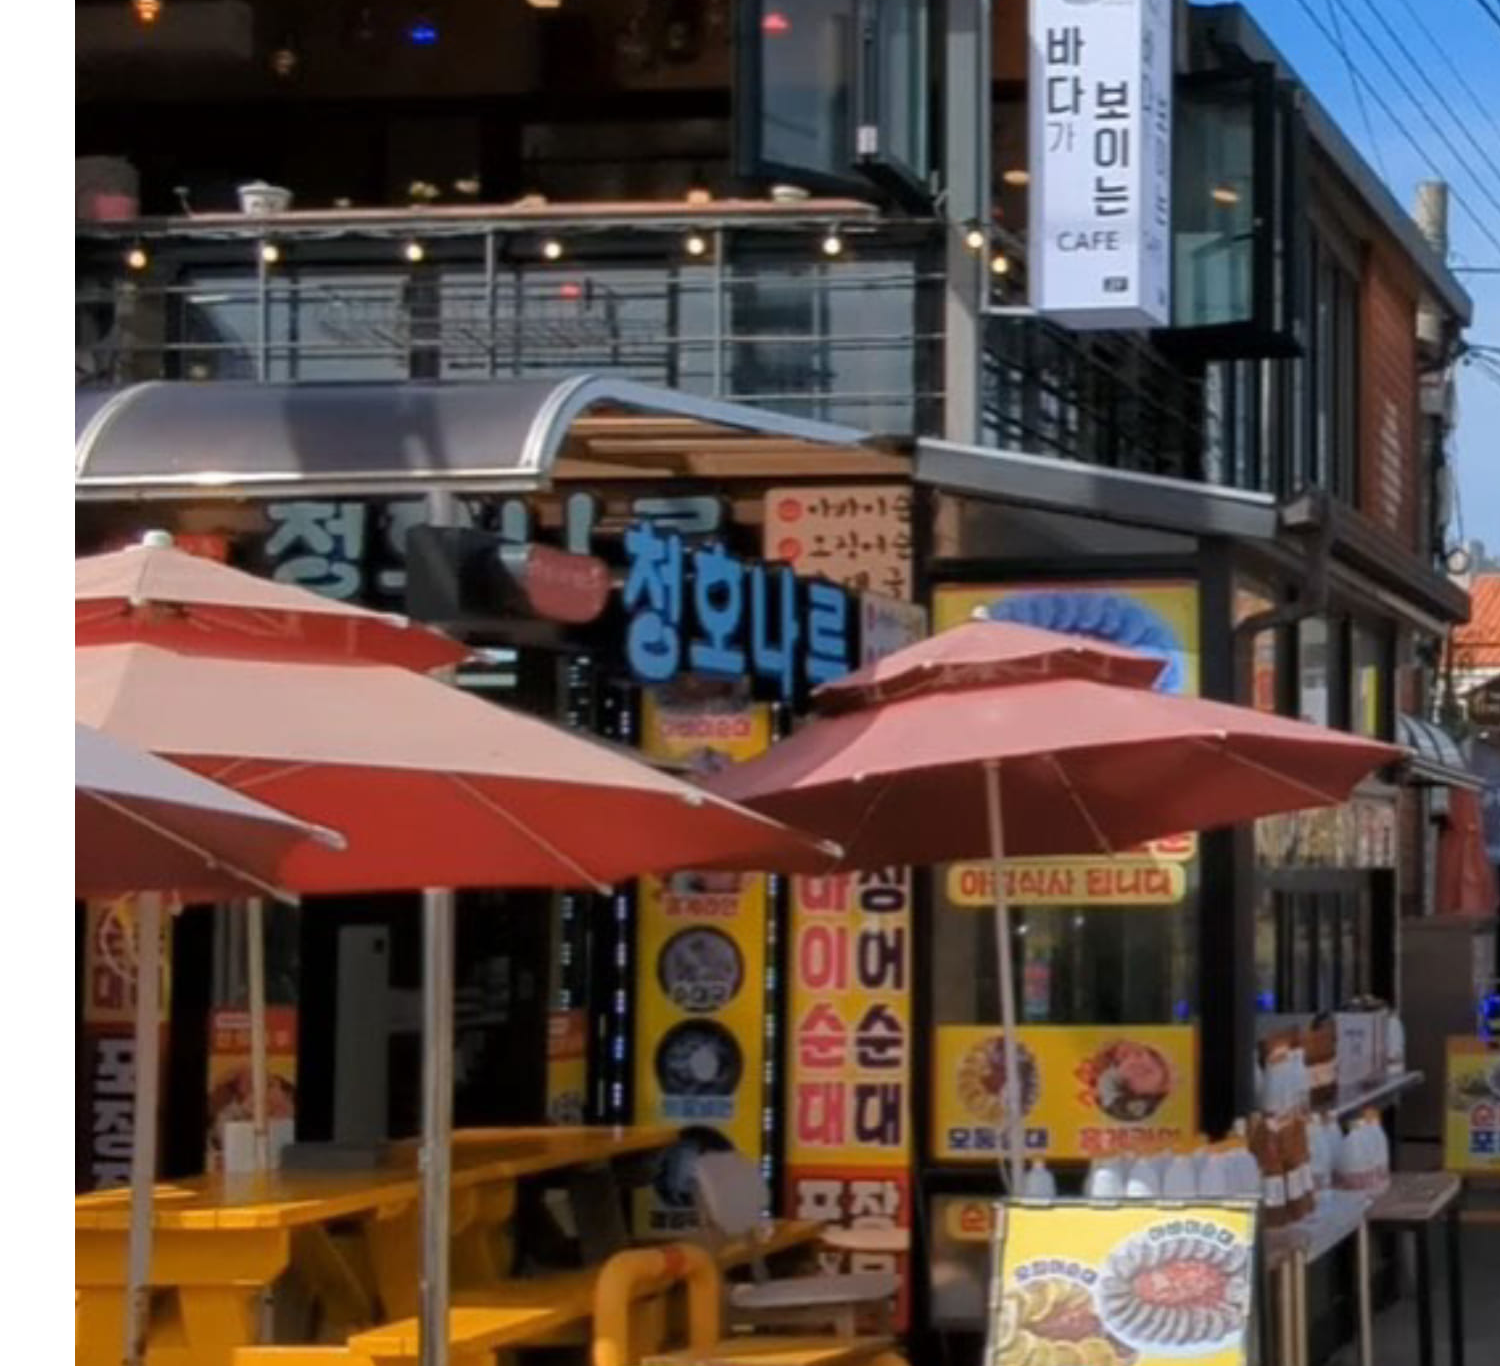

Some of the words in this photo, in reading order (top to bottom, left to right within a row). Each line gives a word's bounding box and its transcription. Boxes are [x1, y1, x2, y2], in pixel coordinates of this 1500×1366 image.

[1047, 26, 1085, 153] 바다가
[1093, 81, 1129, 216] 보이는
[1057, 231, 1119, 251] CAFE
[1086, 867, 1172, 896] 됩니다
